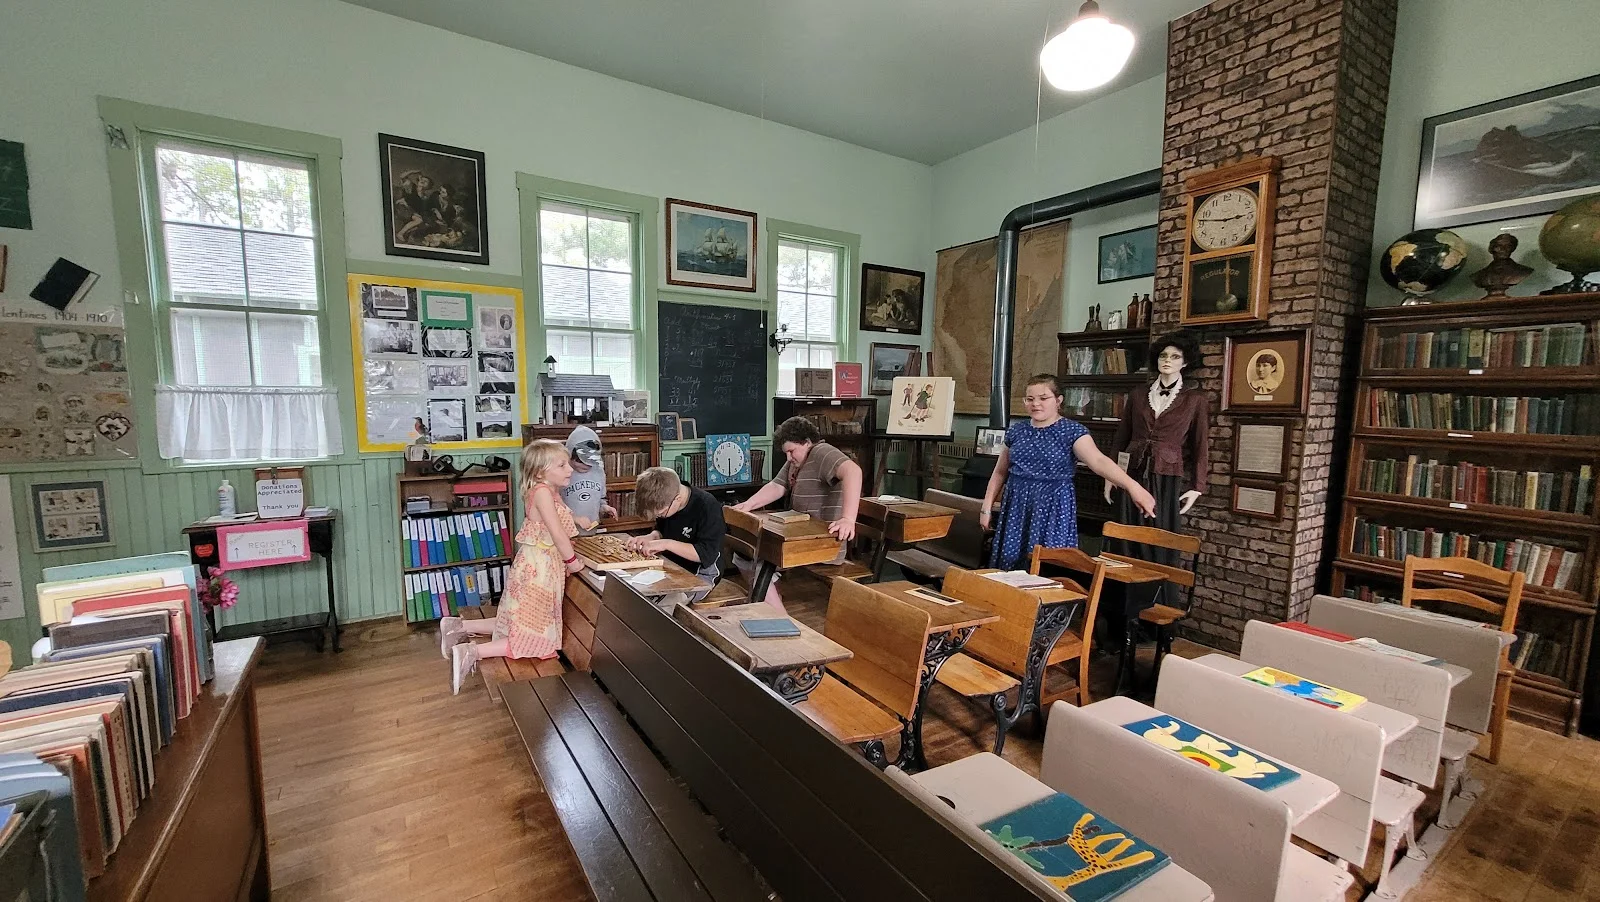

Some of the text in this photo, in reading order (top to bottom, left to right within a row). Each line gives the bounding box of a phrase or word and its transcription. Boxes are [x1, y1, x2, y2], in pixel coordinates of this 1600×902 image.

[1223, 193, 1232, 202] 12
[1244, 200, 1251, 209] 2
[1202, 210, 1211, 218] 10
[1199, 268, 1240, 280] REGULAOR
[86, 313, 108, 323] 1910
[565, 480, 601, 496] PACKERS
[248, 540, 292, 549] REGISTER
[258, 548, 283, 556] HERE
